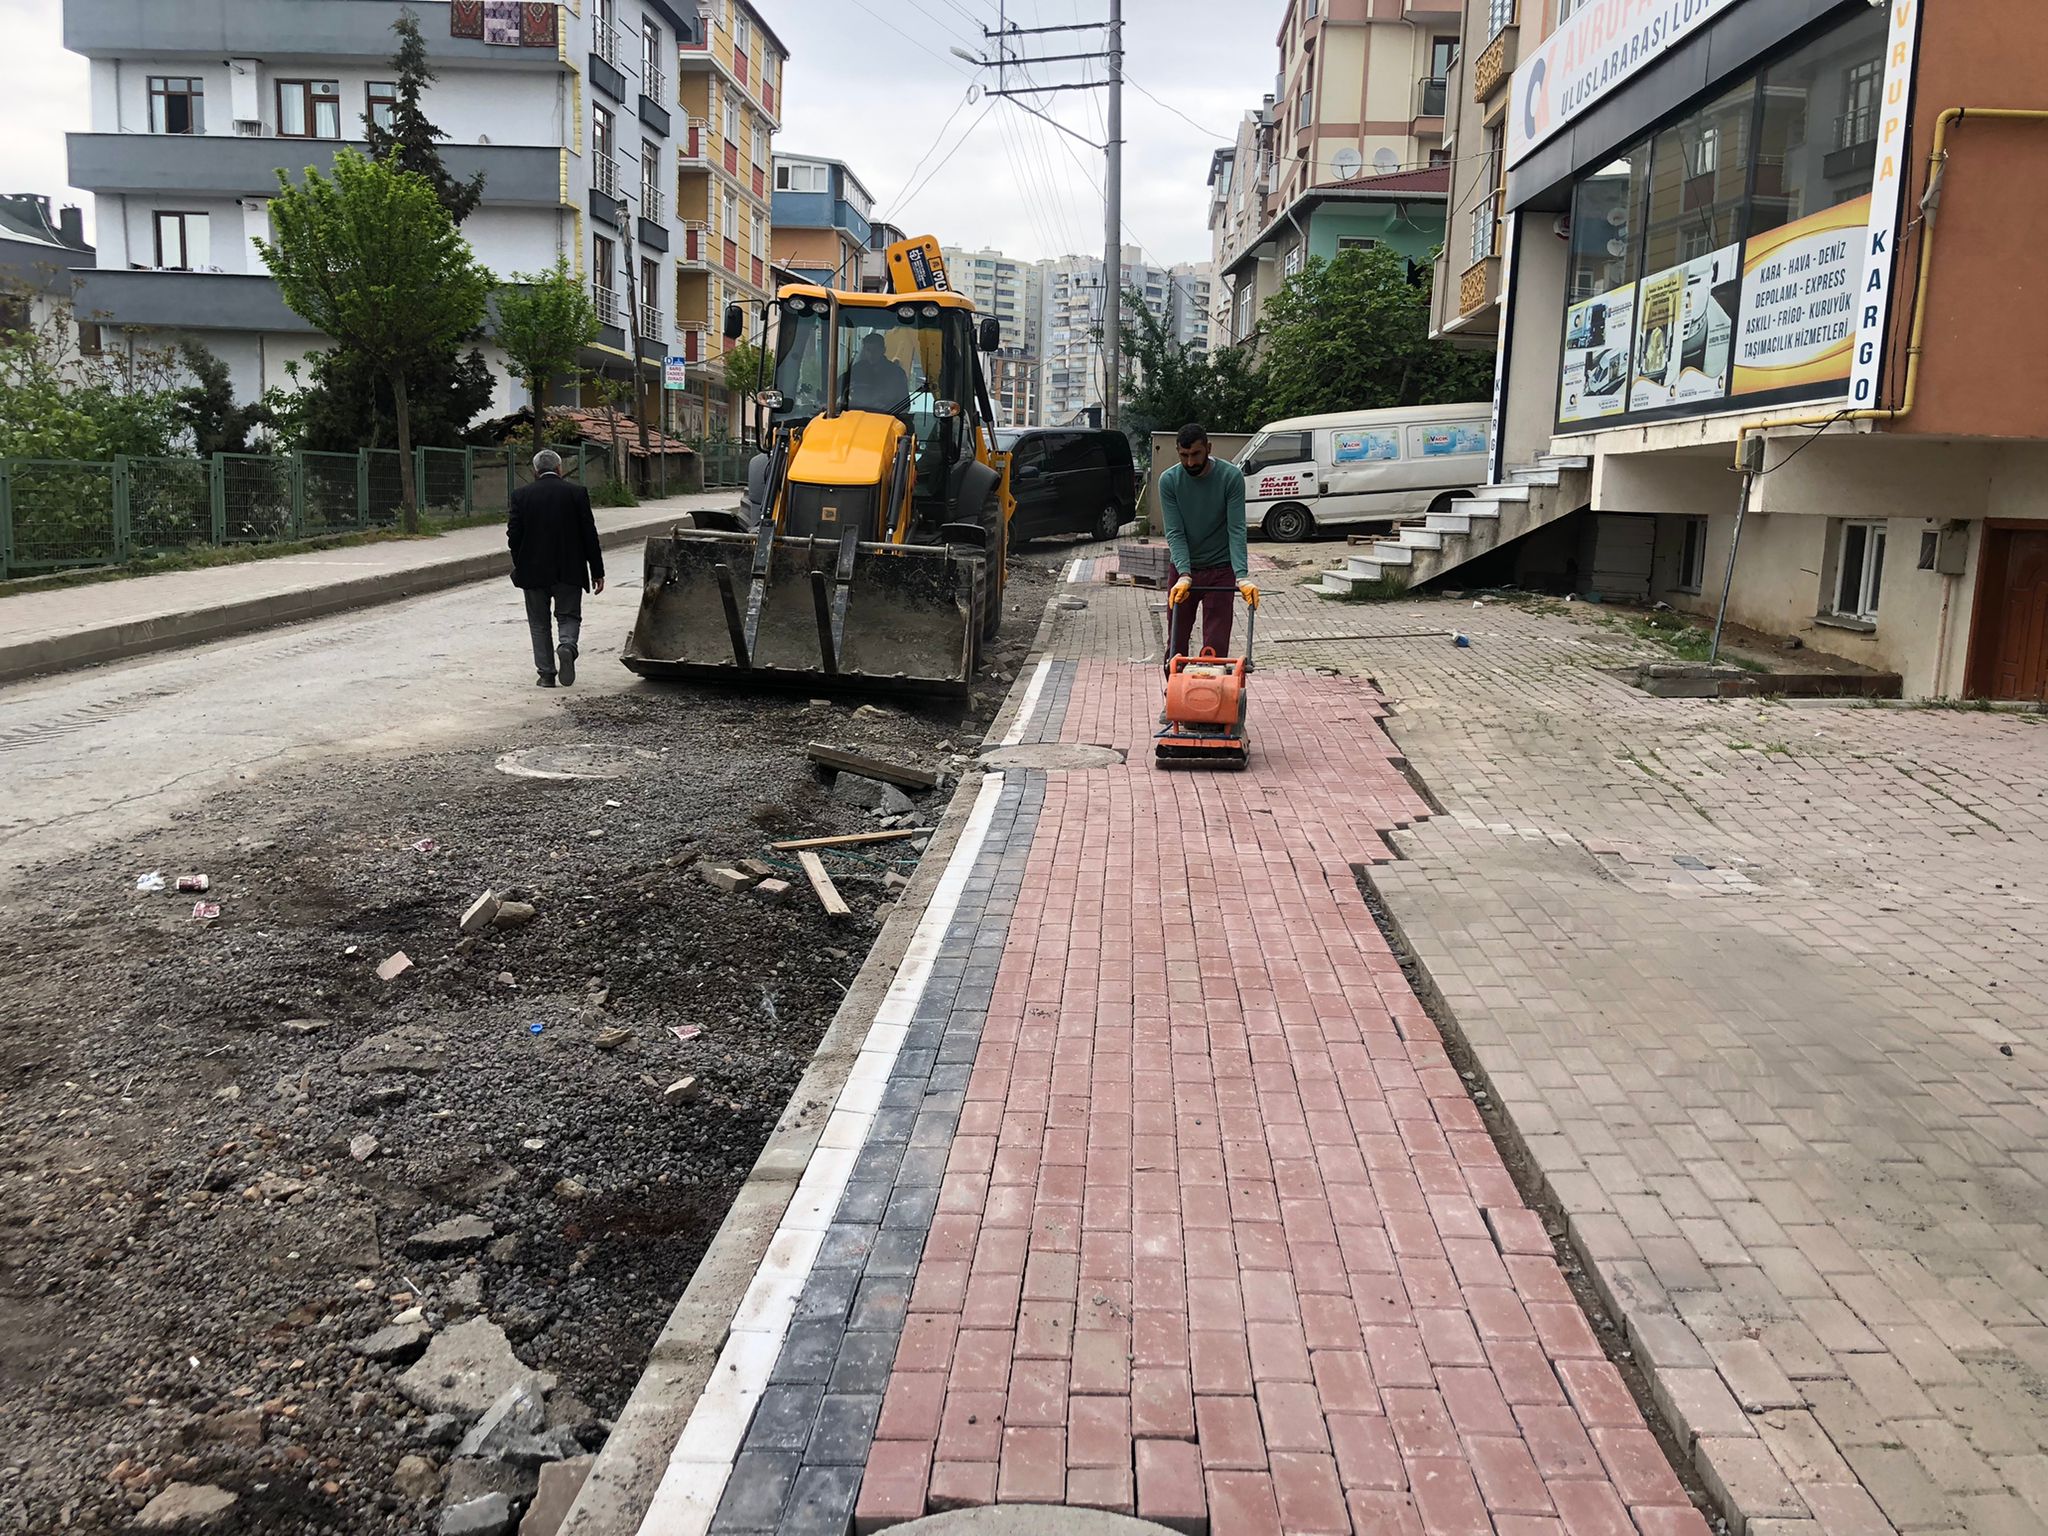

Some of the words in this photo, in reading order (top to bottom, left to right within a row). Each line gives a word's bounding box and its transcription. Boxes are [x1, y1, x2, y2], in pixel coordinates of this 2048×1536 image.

[1561, 10, 1668, 116] ULUSLARARASI
[1760, 263, 1781, 283] KARA
[1788, 253, 1810, 275] HAVA
[1818, 240, 1847, 265] DENİZ
[1755, 282, 1798, 309] DEPOLAMA
[1805, 268, 1846, 295] EXPRESS
[1745, 314, 1771, 335] ASKILI
[1808, 292, 1852, 319] KURUYÜK
[1855, 229, 1888, 401] KARGO
[1744, 335, 1792, 359] TAŞIMACILIK
[1794, 317, 1848, 346] HİZMETLERİ
